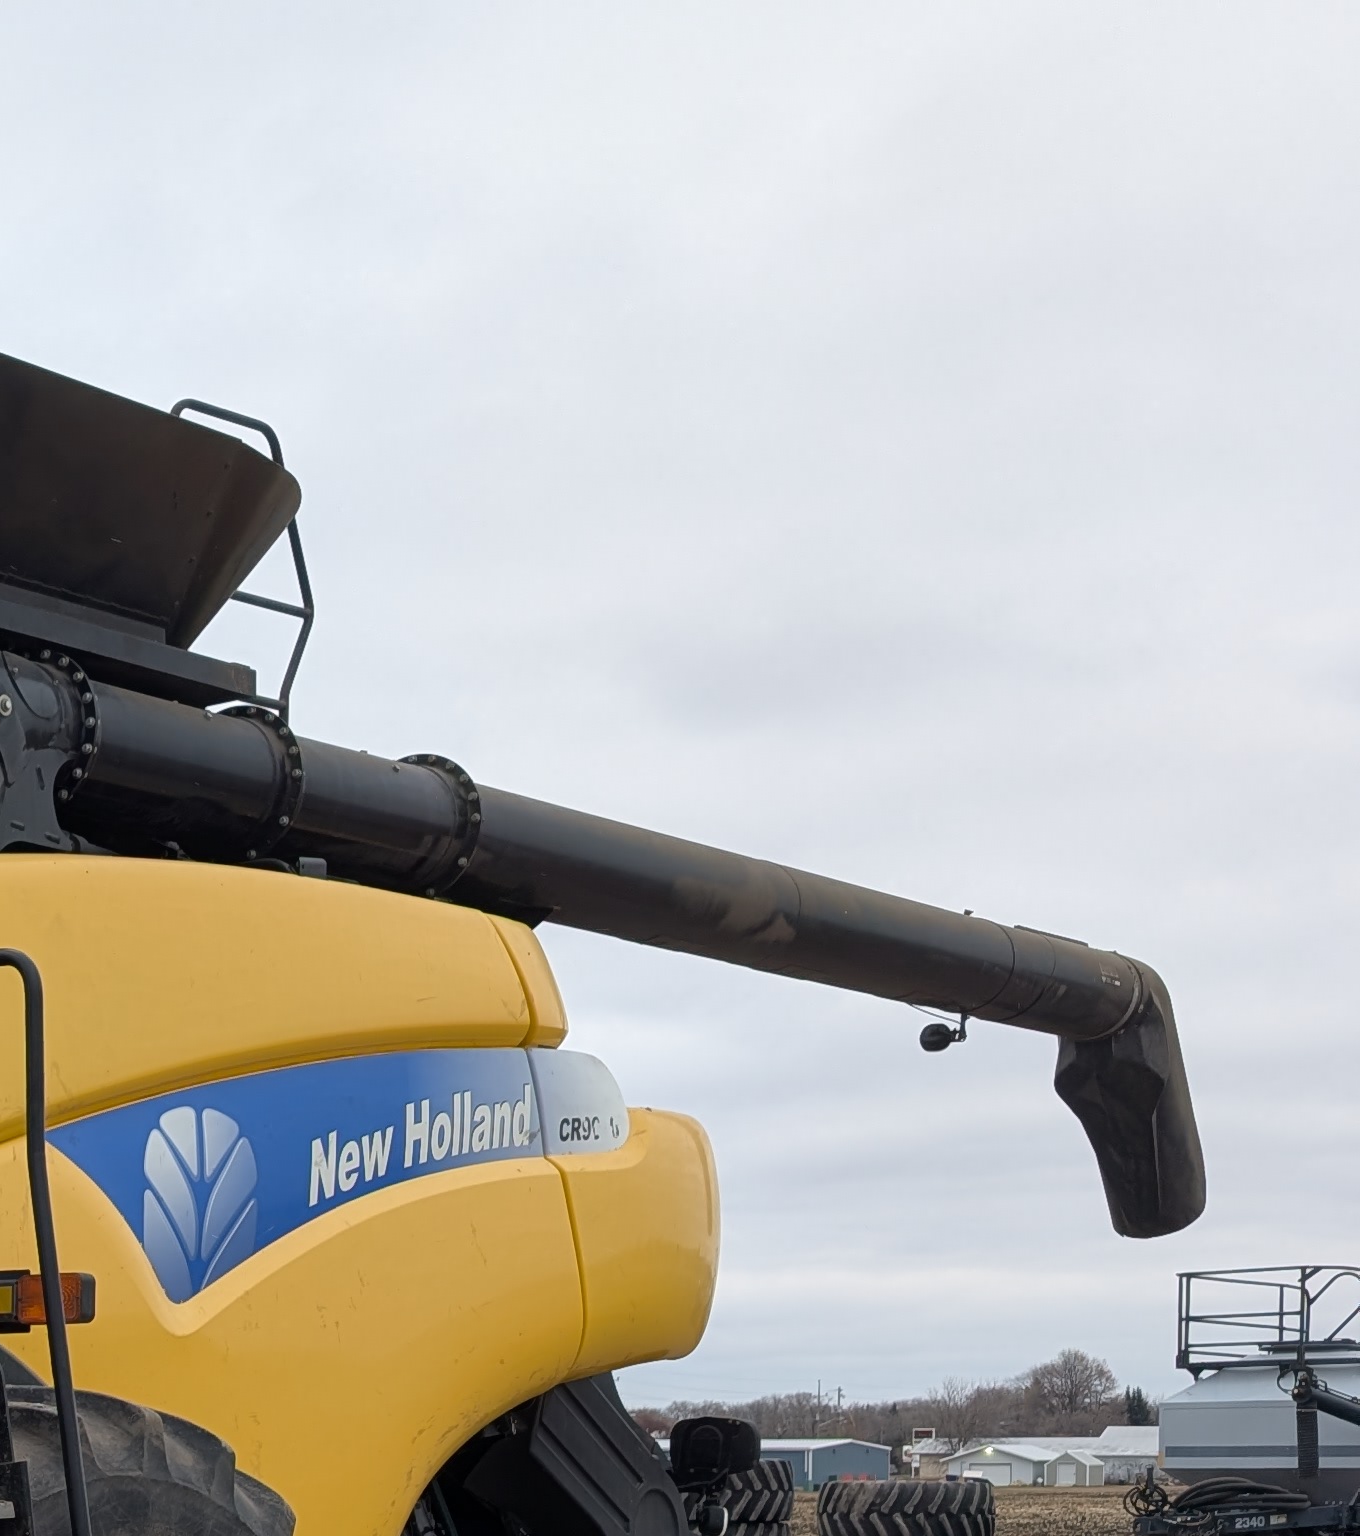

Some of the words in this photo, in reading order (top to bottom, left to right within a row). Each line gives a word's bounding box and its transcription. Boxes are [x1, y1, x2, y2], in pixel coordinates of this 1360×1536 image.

[309, 1125, 394, 1207] New
[404, 1084, 531, 1168] Holland
[1235, 1516, 1265, 1529] 2340
